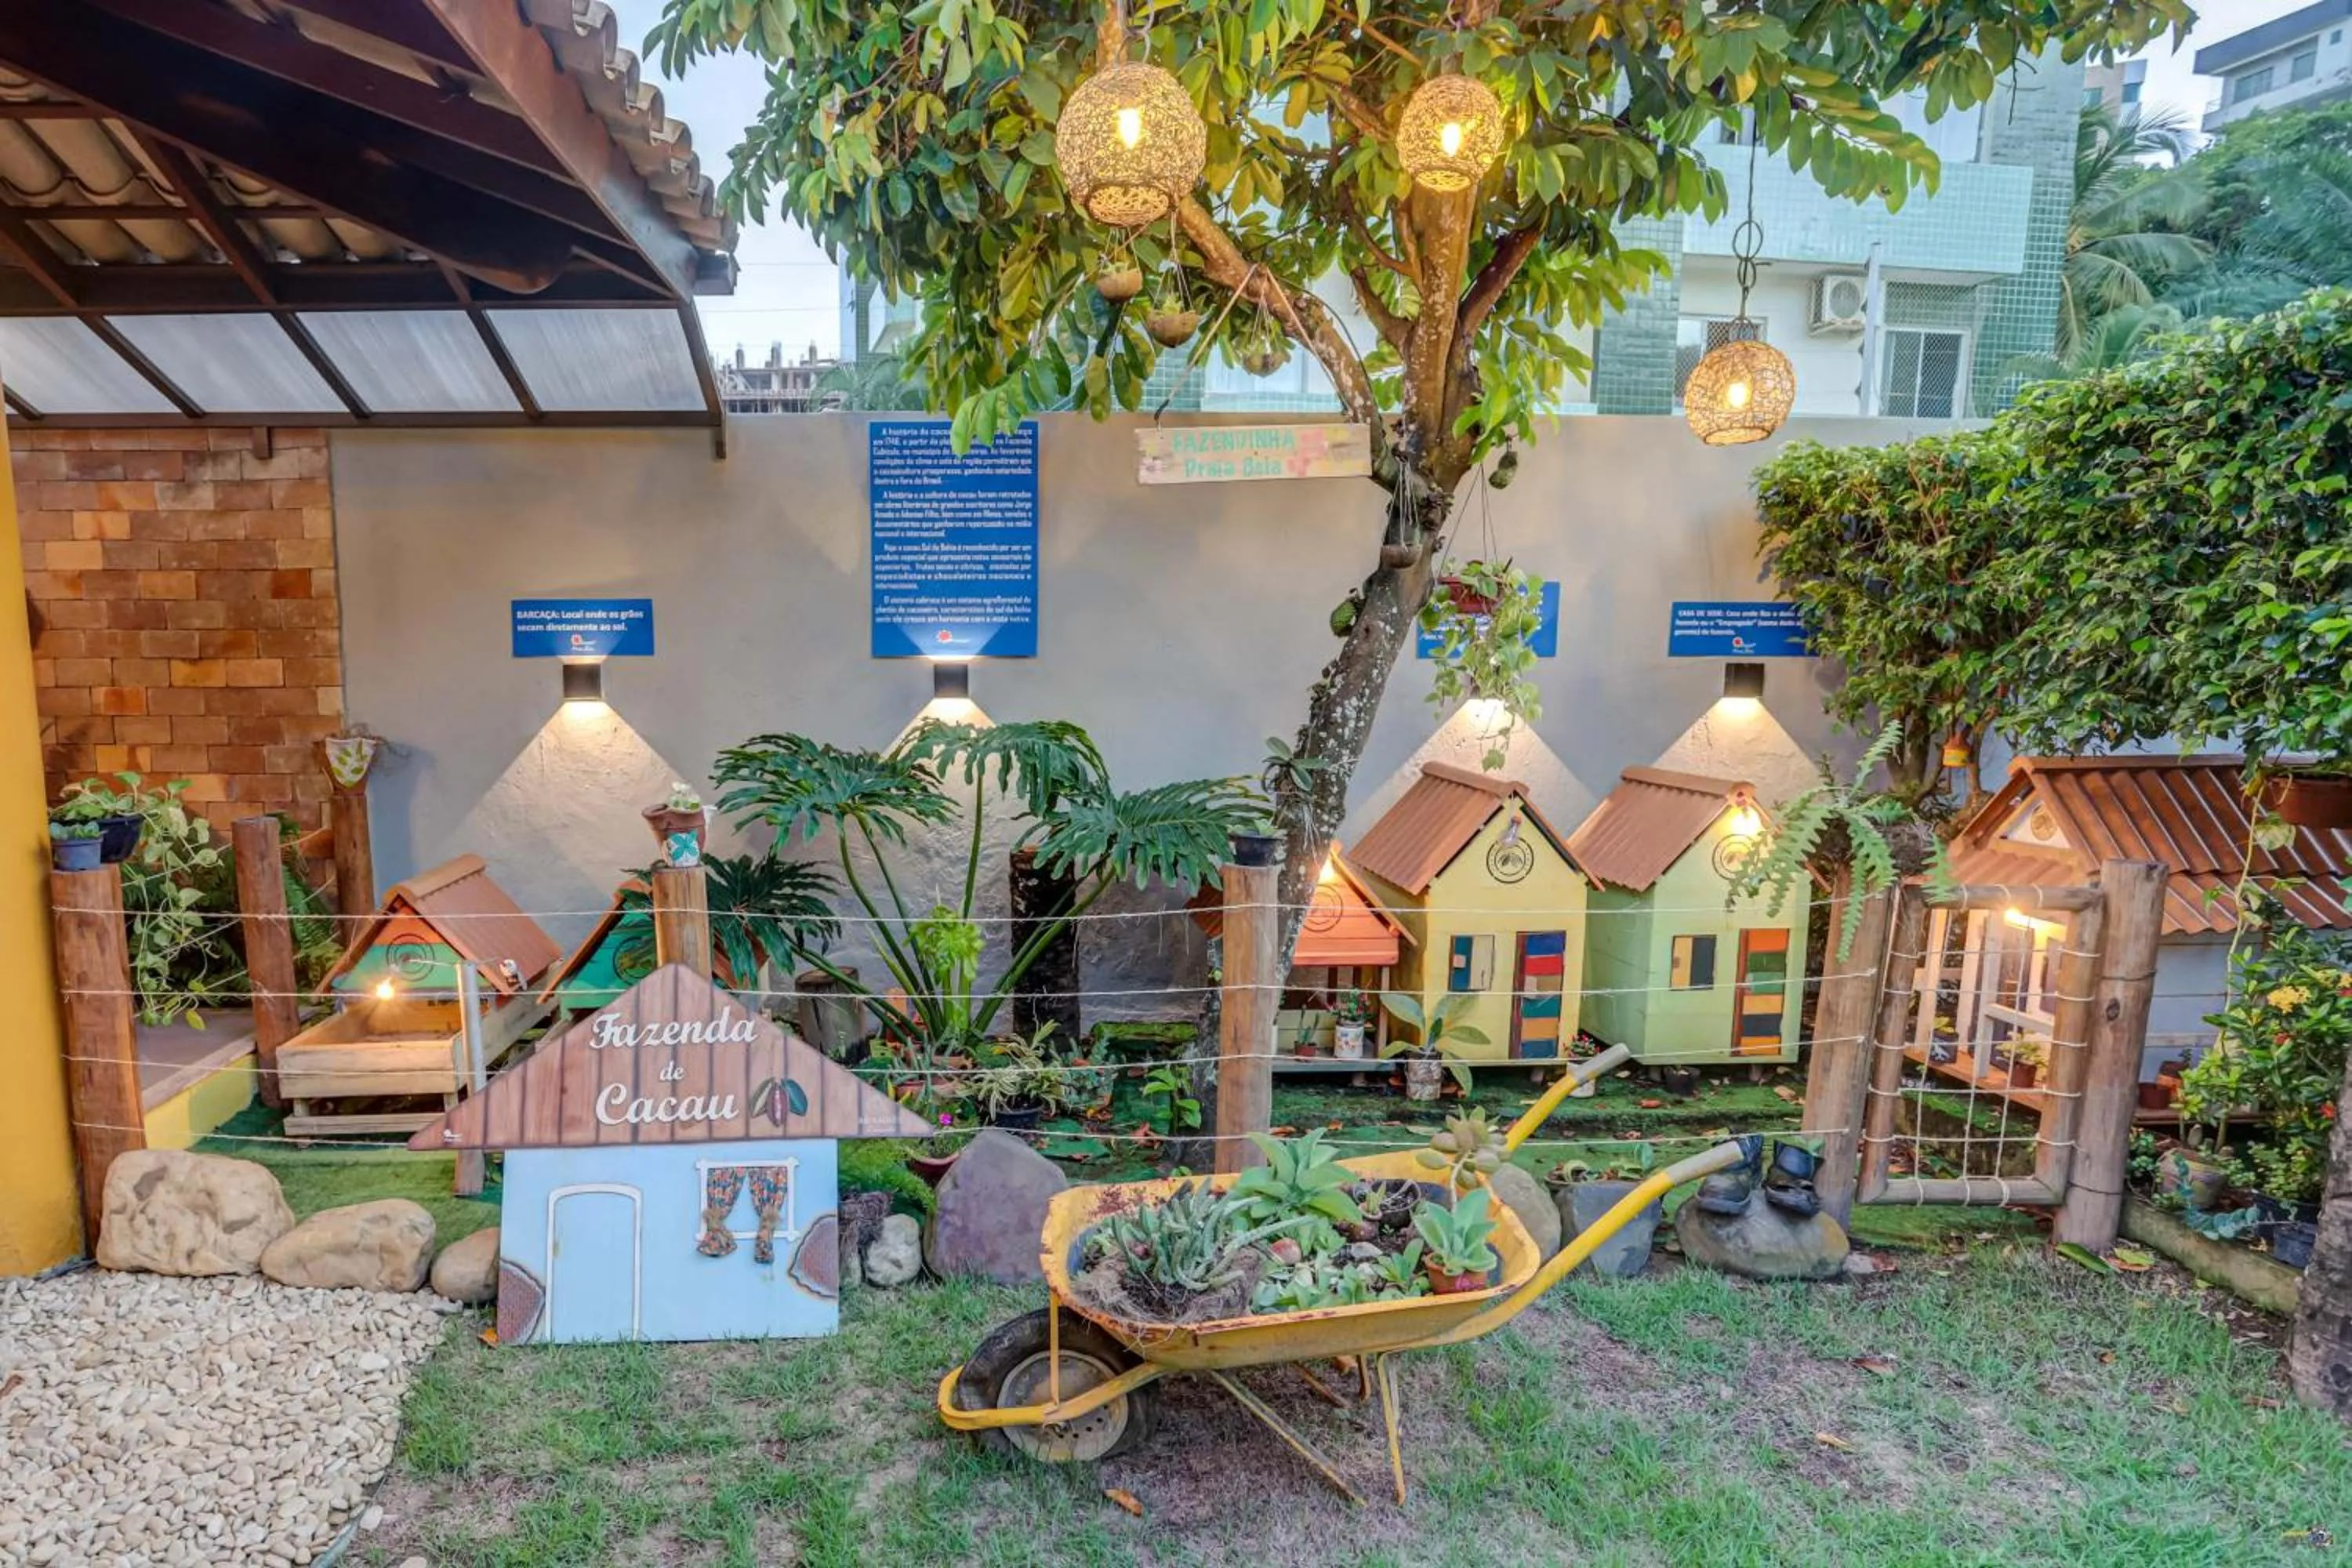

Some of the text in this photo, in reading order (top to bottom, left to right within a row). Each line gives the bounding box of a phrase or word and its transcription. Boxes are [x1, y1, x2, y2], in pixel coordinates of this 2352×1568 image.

[1173, 430, 1294, 452] FAZENDINHA
[1185, 458, 1236, 477] Praia
[517, 611, 561, 619] BARCAÇA:
[561, 610, 584, 619] Local
[585, 609, 607, 619] onde
[620, 609, 644, 620] grãos
[612, 622, 627, 631] sol.
[589, 1004, 759, 1050] Fazenda
[659, 1060, 685, 1082] de
[595, 1082, 739, 1127] Cacau
